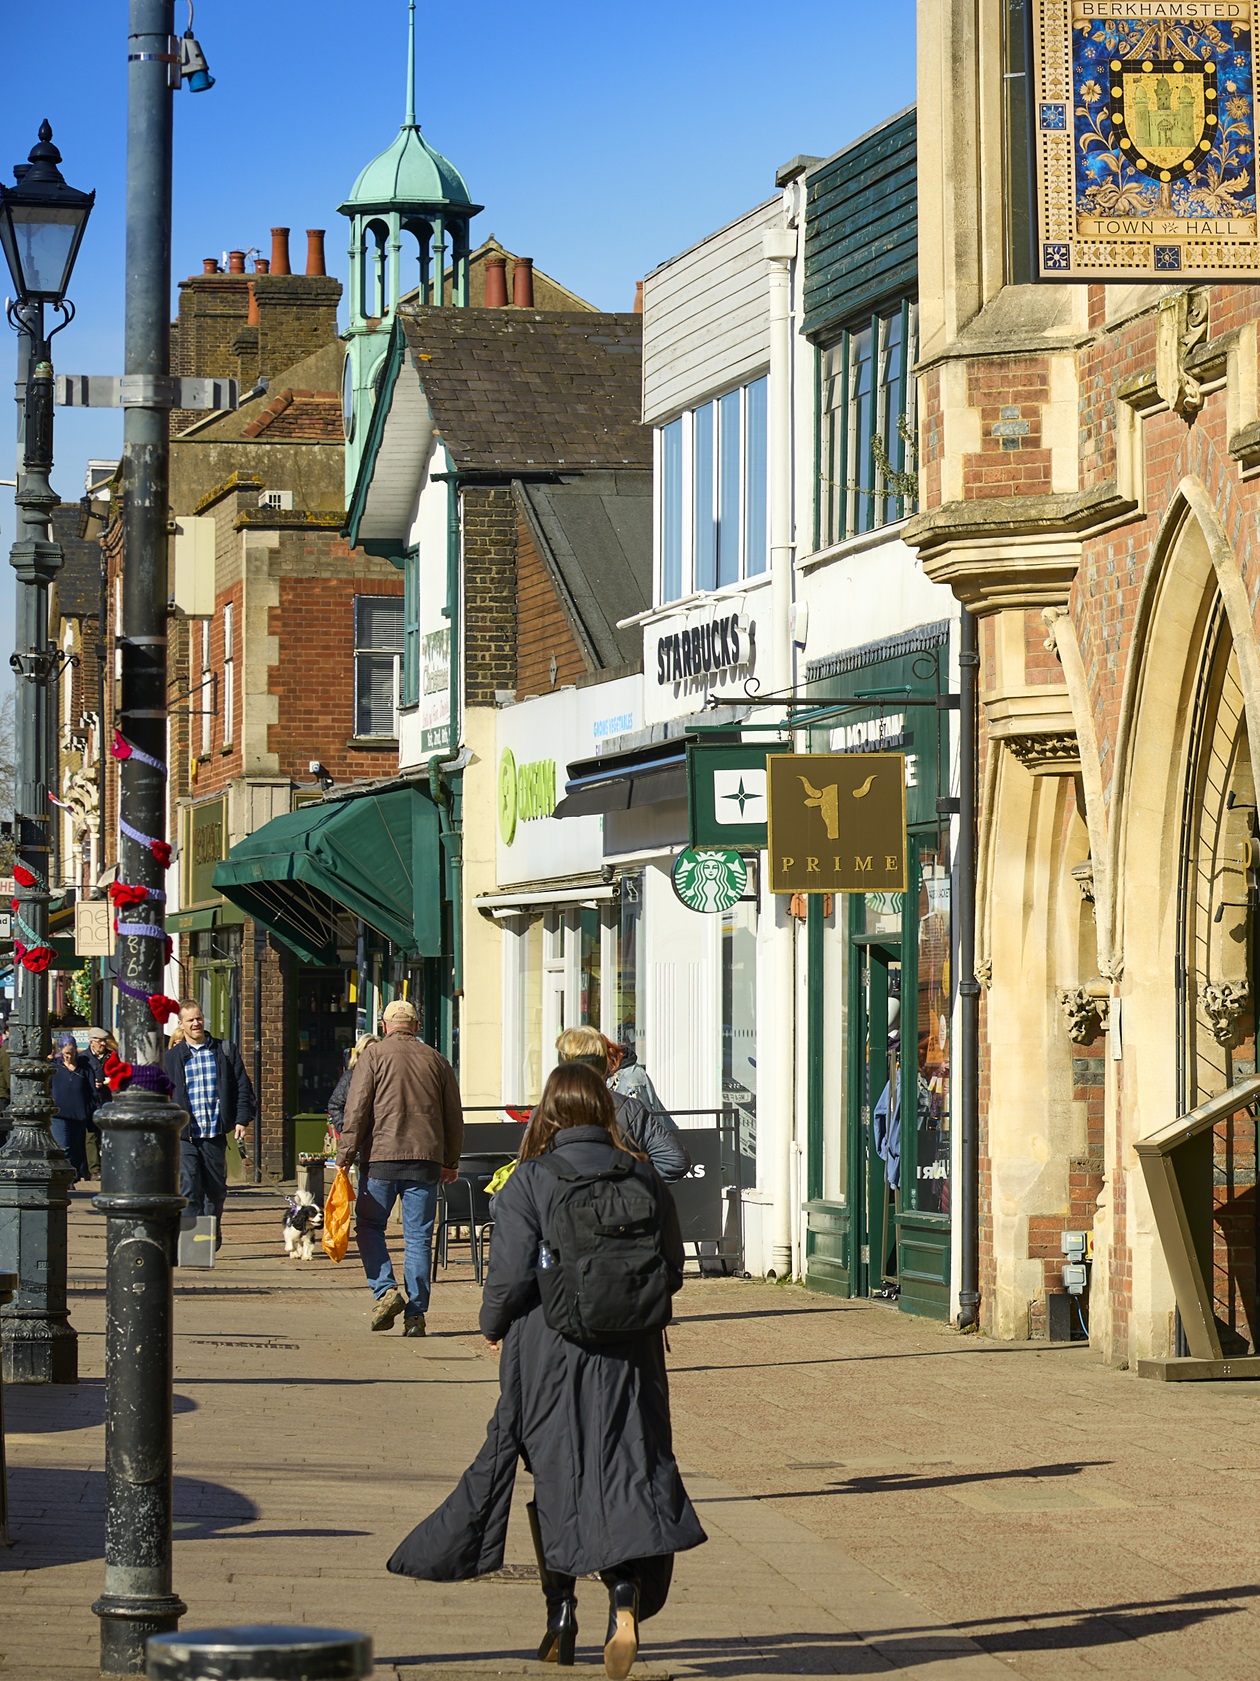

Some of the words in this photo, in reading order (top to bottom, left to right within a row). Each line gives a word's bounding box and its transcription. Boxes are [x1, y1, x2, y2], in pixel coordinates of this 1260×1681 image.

[1082, 2, 1241, 18] BERKHAMSTED
[1093, 220, 1154, 235] TOWN
[1186, 220, 1238, 235] HALL
[657, 613, 740, 686] STARBUCKS
[781, 856, 899, 872] PRIME
